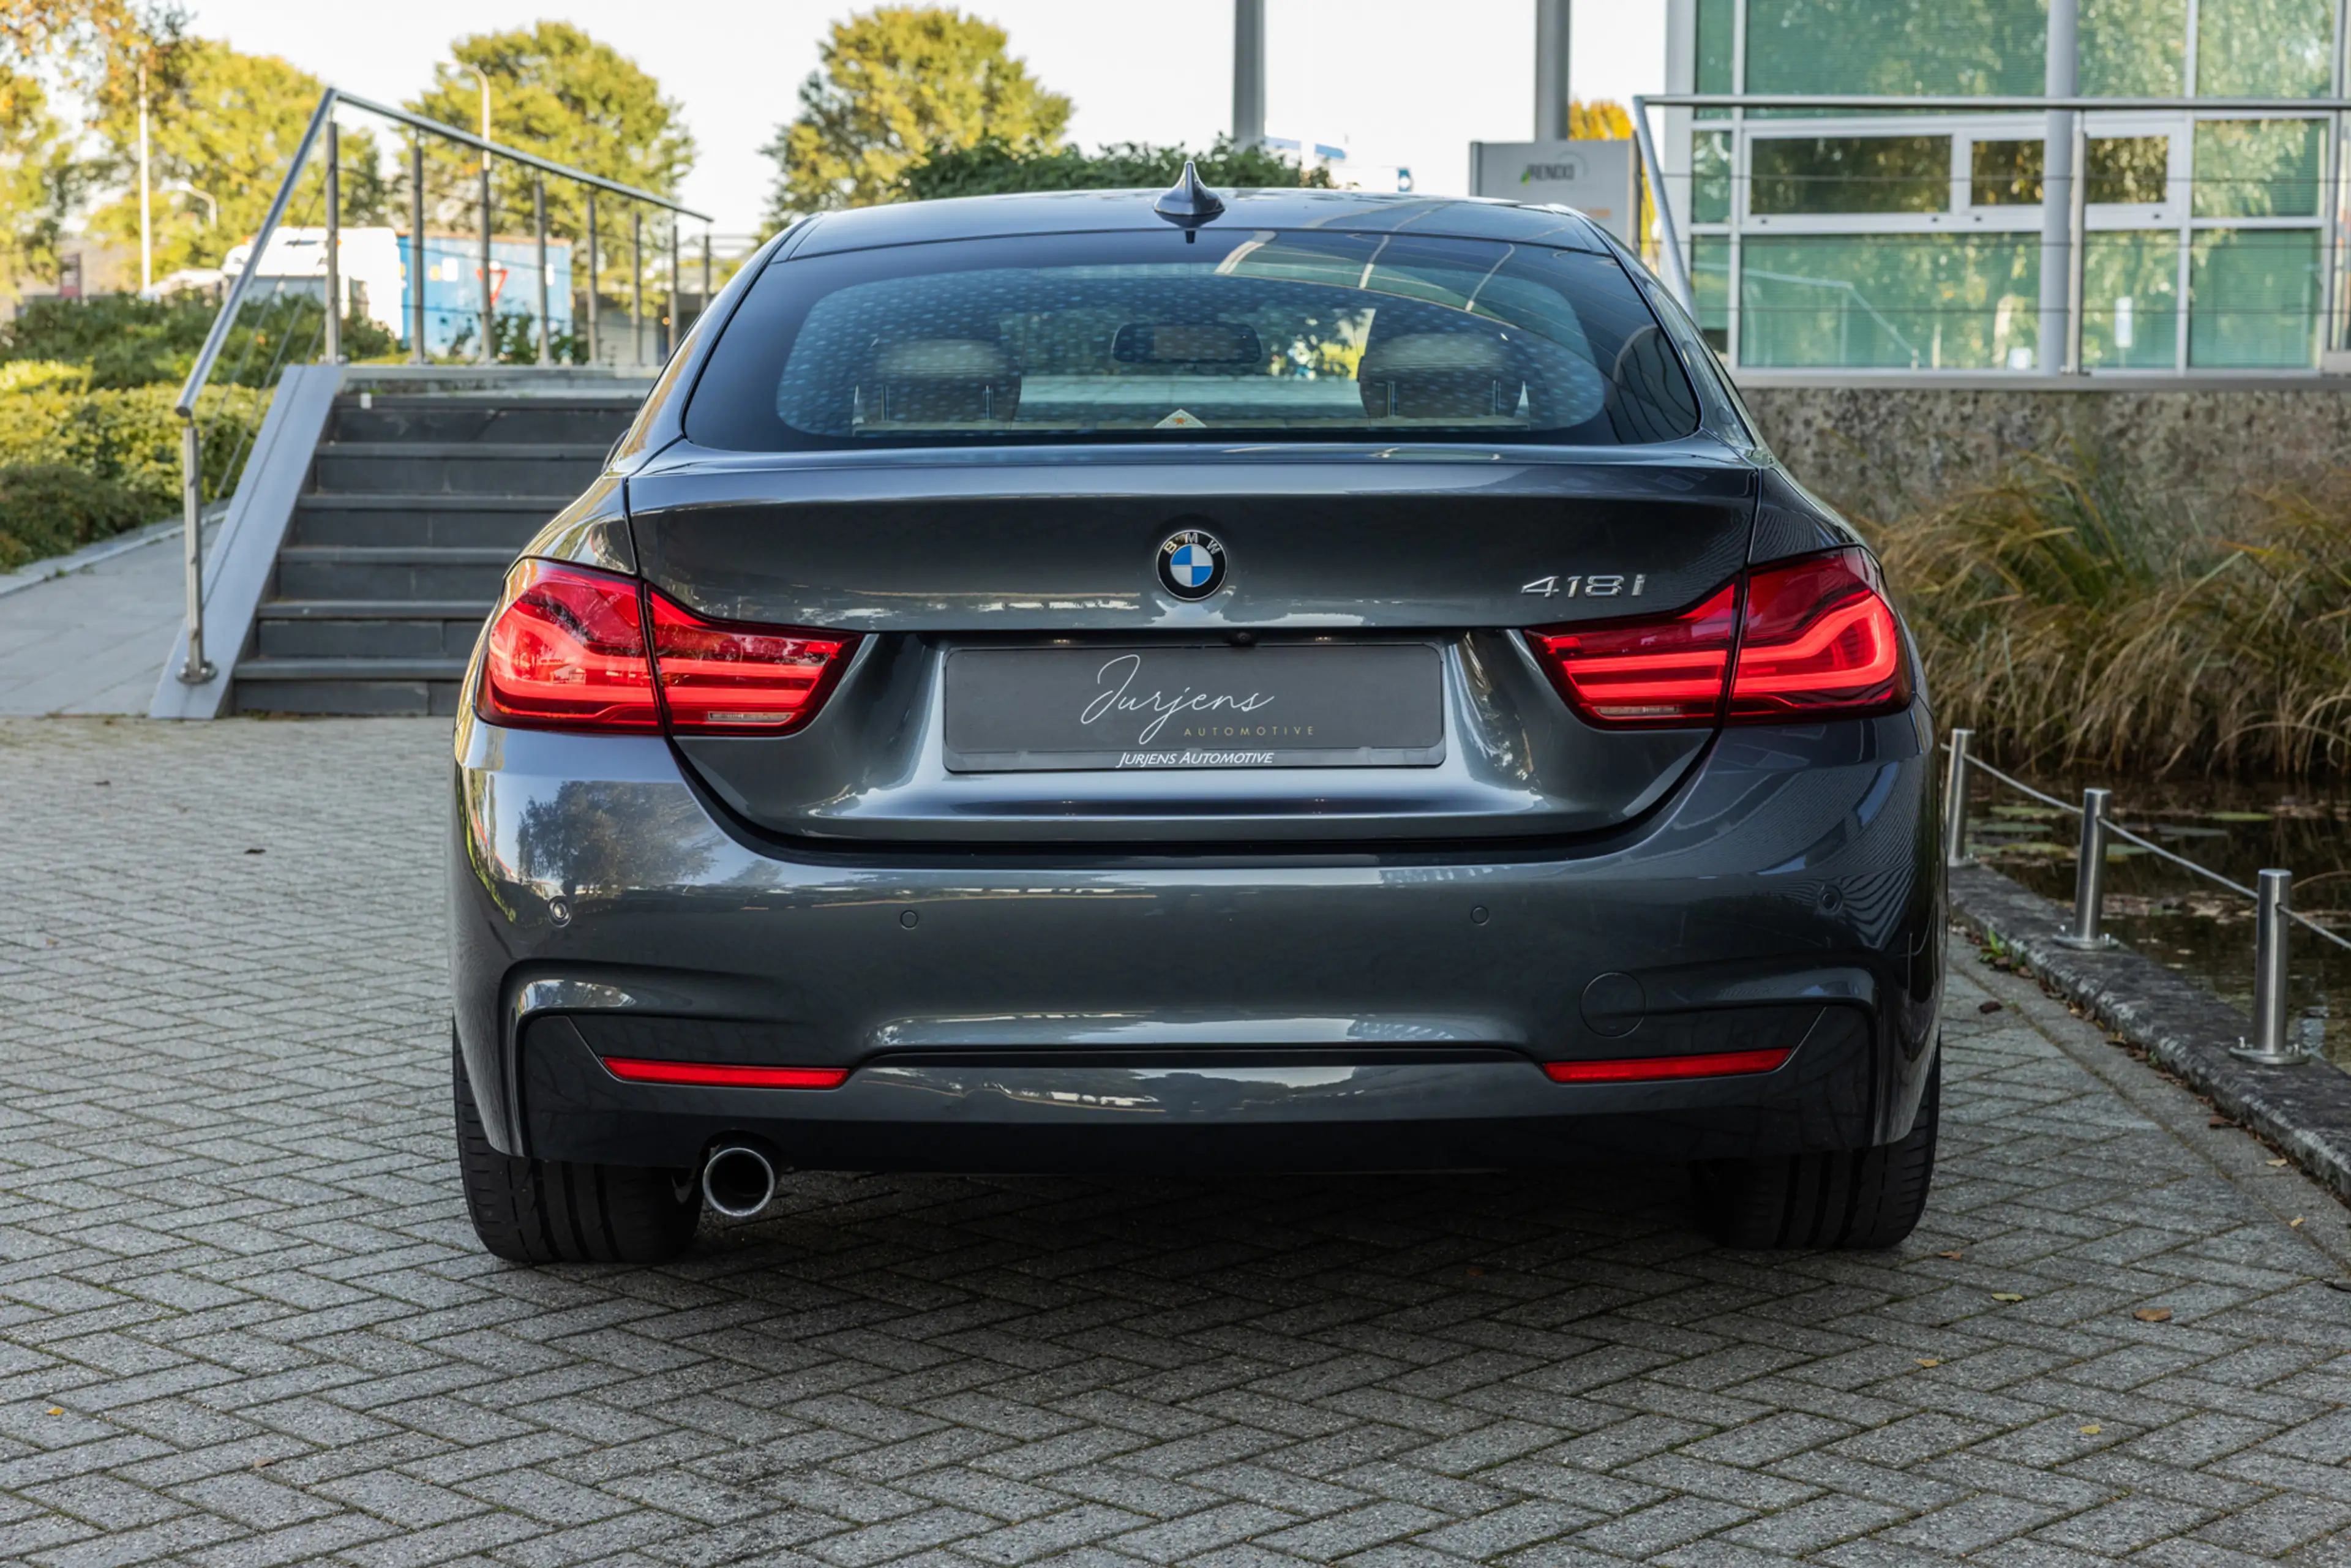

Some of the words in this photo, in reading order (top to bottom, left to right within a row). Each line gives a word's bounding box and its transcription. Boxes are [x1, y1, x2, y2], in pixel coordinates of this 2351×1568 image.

[1164, 533, 1220, 555] BMW
[1521, 574, 1646, 598] 418i
[1081, 654, 1275, 745] Jurjens
[1183, 726, 1314, 737] AUTOMOTIVE
[1116, 752, 1177, 768] JURJENS
[1179, 752, 1275, 764] AUTOMOTIVE
